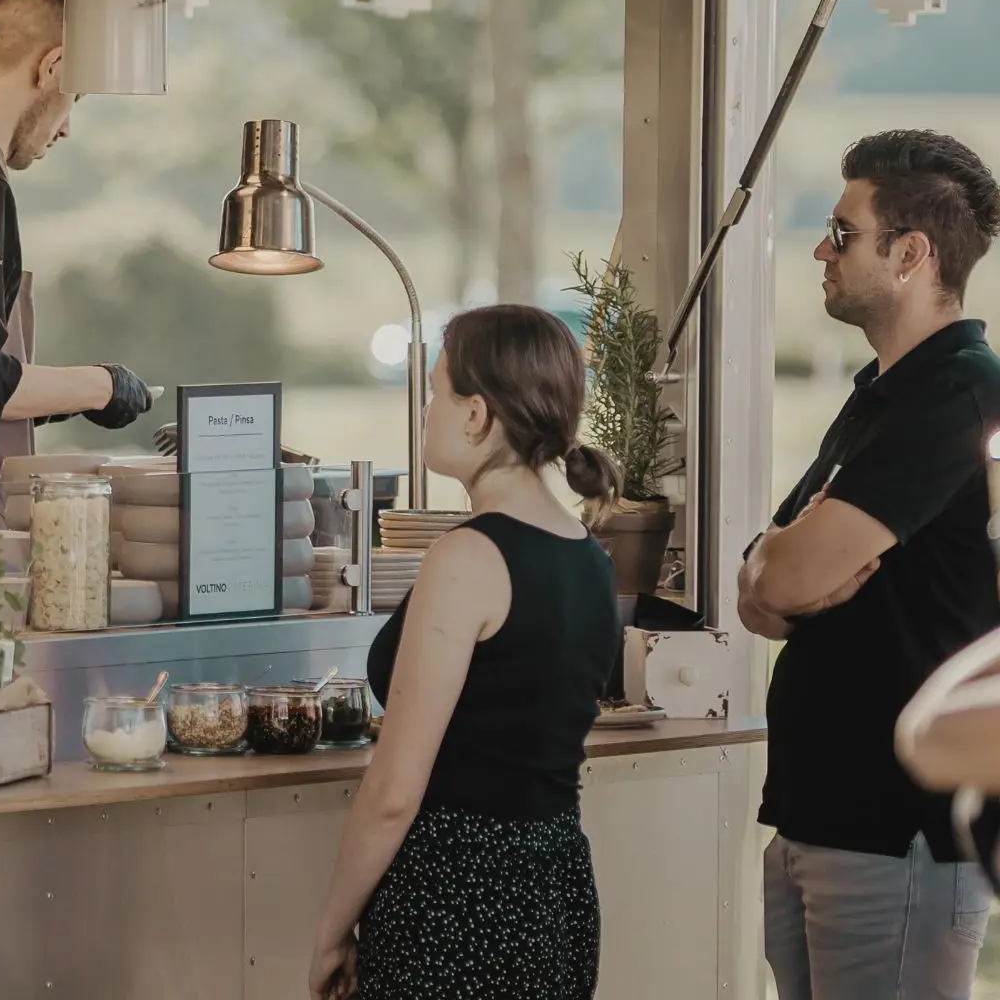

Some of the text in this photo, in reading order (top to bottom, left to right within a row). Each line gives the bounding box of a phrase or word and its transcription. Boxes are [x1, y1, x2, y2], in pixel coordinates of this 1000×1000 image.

[208, 415, 228, 426] Pasta
[235, 414, 254, 425] Pinsa
[196, 583, 227, 594] VOLTINO
